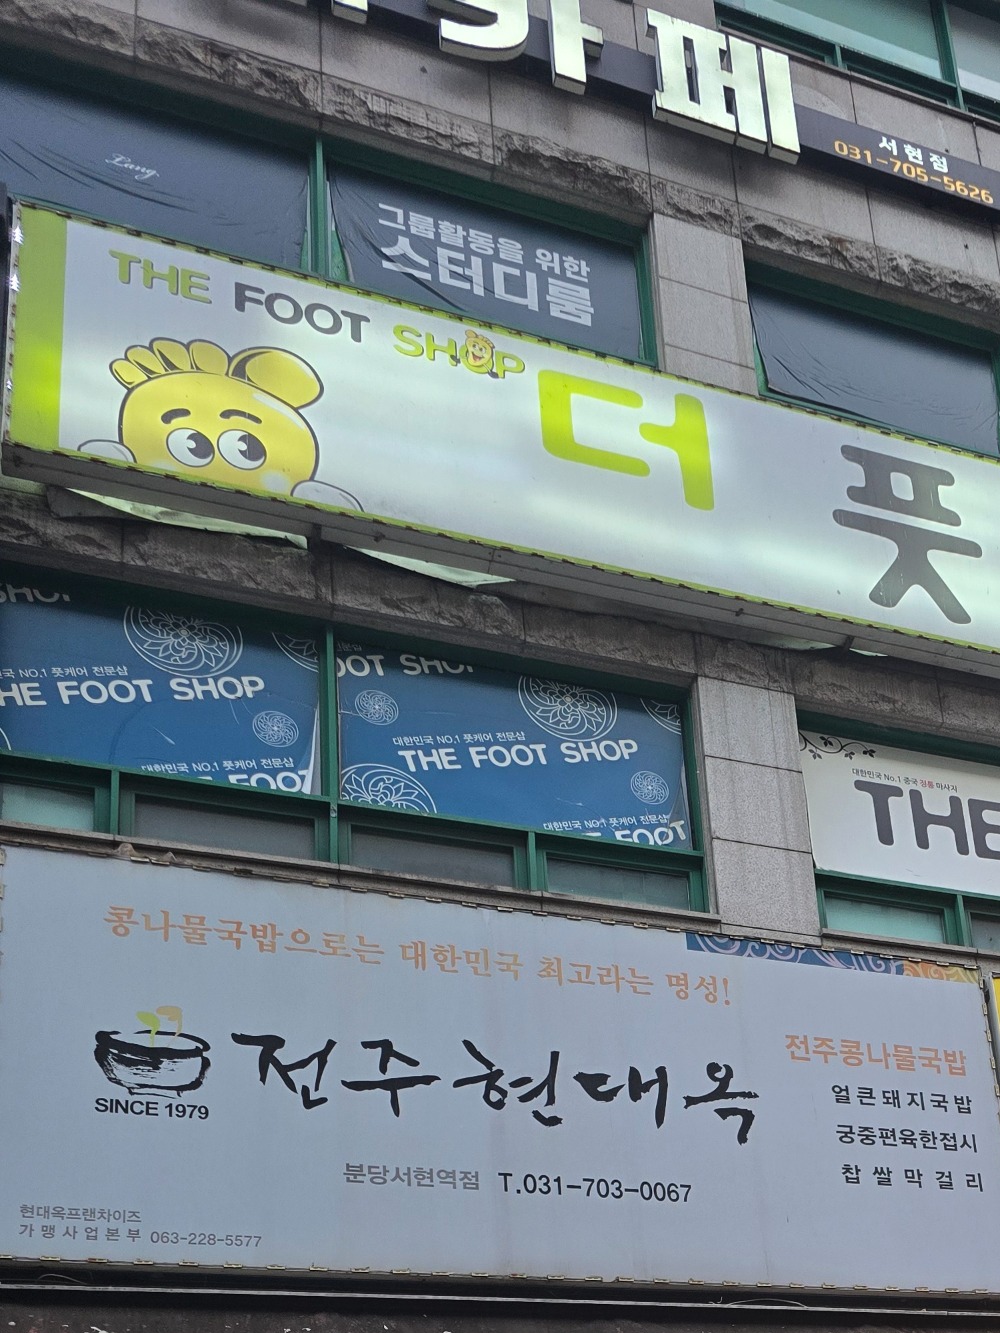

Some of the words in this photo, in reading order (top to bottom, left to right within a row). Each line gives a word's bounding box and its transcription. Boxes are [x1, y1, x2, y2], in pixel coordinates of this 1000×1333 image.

[879, 136, 949, 173] 서현점
[834, 141, 994, 205] 031-705-5626
[379, 203, 524, 264] 그룹활동을
[536, 249, 591, 283] 위한
[381, 235, 594, 327] 스터디룸
[109, 249, 212, 304] THE
[233, 282, 370, 343] FOOT
[393, 323, 526, 379] SHOP
[18, 667, 49, 679] NO.1
[52, 666, 89, 679] 풋케어
[57, 679, 153, 705] FOOT
[169, 675, 265, 701] SHOP
[397, 748, 462, 773] THE
[471, 743, 547, 769] FOOT
[559, 738, 639, 765] SHOP
[436, 734, 461, 745] NO.1
[852, 768, 883, 781] 대한민국
[883, 773, 902, 784] No.1
[903, 776, 919, 787] 중국
[104, 905, 386, 966] 콩나물국밥으로는
[399, 940, 524, 981] 대한민국
[536, 956, 656, 997] 최고라는
[665, 971, 733, 1006] 명성!
[784, 1033, 968, 1077] 전주콩나물국밥
[231, 1032, 760, 1145] 전주현대옥
[831, 1083, 973, 1115] 얼큰돼지국밥
[94, 1098, 160, 1118] SINCE
[164, 1101, 210, 1121] 1979
[835, 1123, 979, 1154] 궁중편육한접시
[343, 1162, 481, 1192] 분당서현역점
[497, 1170, 693, 1204] T.031-703-0067
[841, 1162, 985, 1193] 찹쌀막걸리
[19, 1202, 142, 1224] 현대옥프랜차이즈
[19, 1222, 143, 1244] 가맹사업본부
[149, 1229, 263, 1249] 063-228-5577
